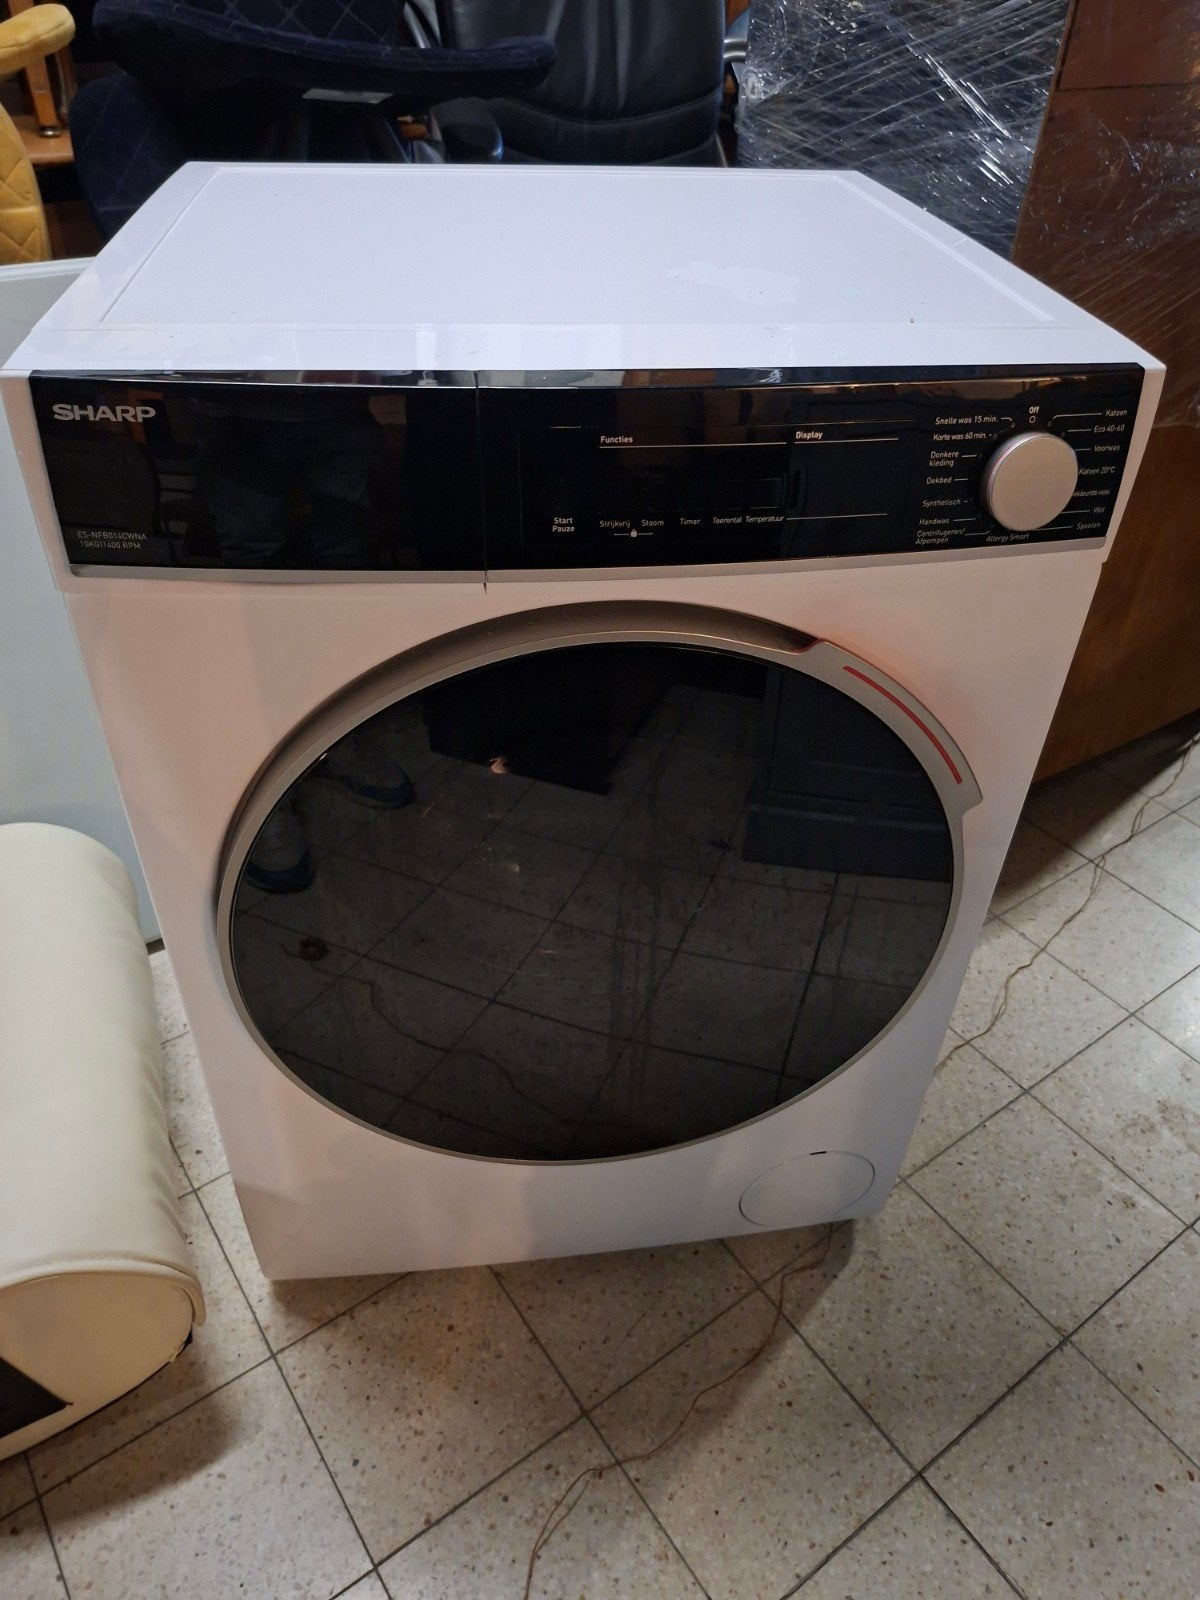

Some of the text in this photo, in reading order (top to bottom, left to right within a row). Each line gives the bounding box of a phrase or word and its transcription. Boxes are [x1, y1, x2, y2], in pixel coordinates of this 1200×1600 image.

[52, 403, 157, 423] SHARP
[1029, 406, 1039, 414] Off
[935, 417, 957, 425] Snelle
[1094, 424, 1125, 433] Eco 40-60
[795, 430, 823, 440] Display
[965, 432, 973, 440] 60
[600, 435, 634, 444] Functies
[930, 451, 959, 459] Donkere
[929, 460, 954, 468] kleding
[926, 477, 952, 485] Dekbed
[922, 499, 961, 508] Synthetisch
[553, 517, 573, 525] Start
[599, 519, 631, 528] Strijkvrij
[712, 516, 742, 524] Toerental
[745, 515, 785, 524] Temperatuur
[1076, 522, 1101, 530] Spoelen
[986, 535, 1008, 543] Allergy
[122, 541, 141, 550] RPM
